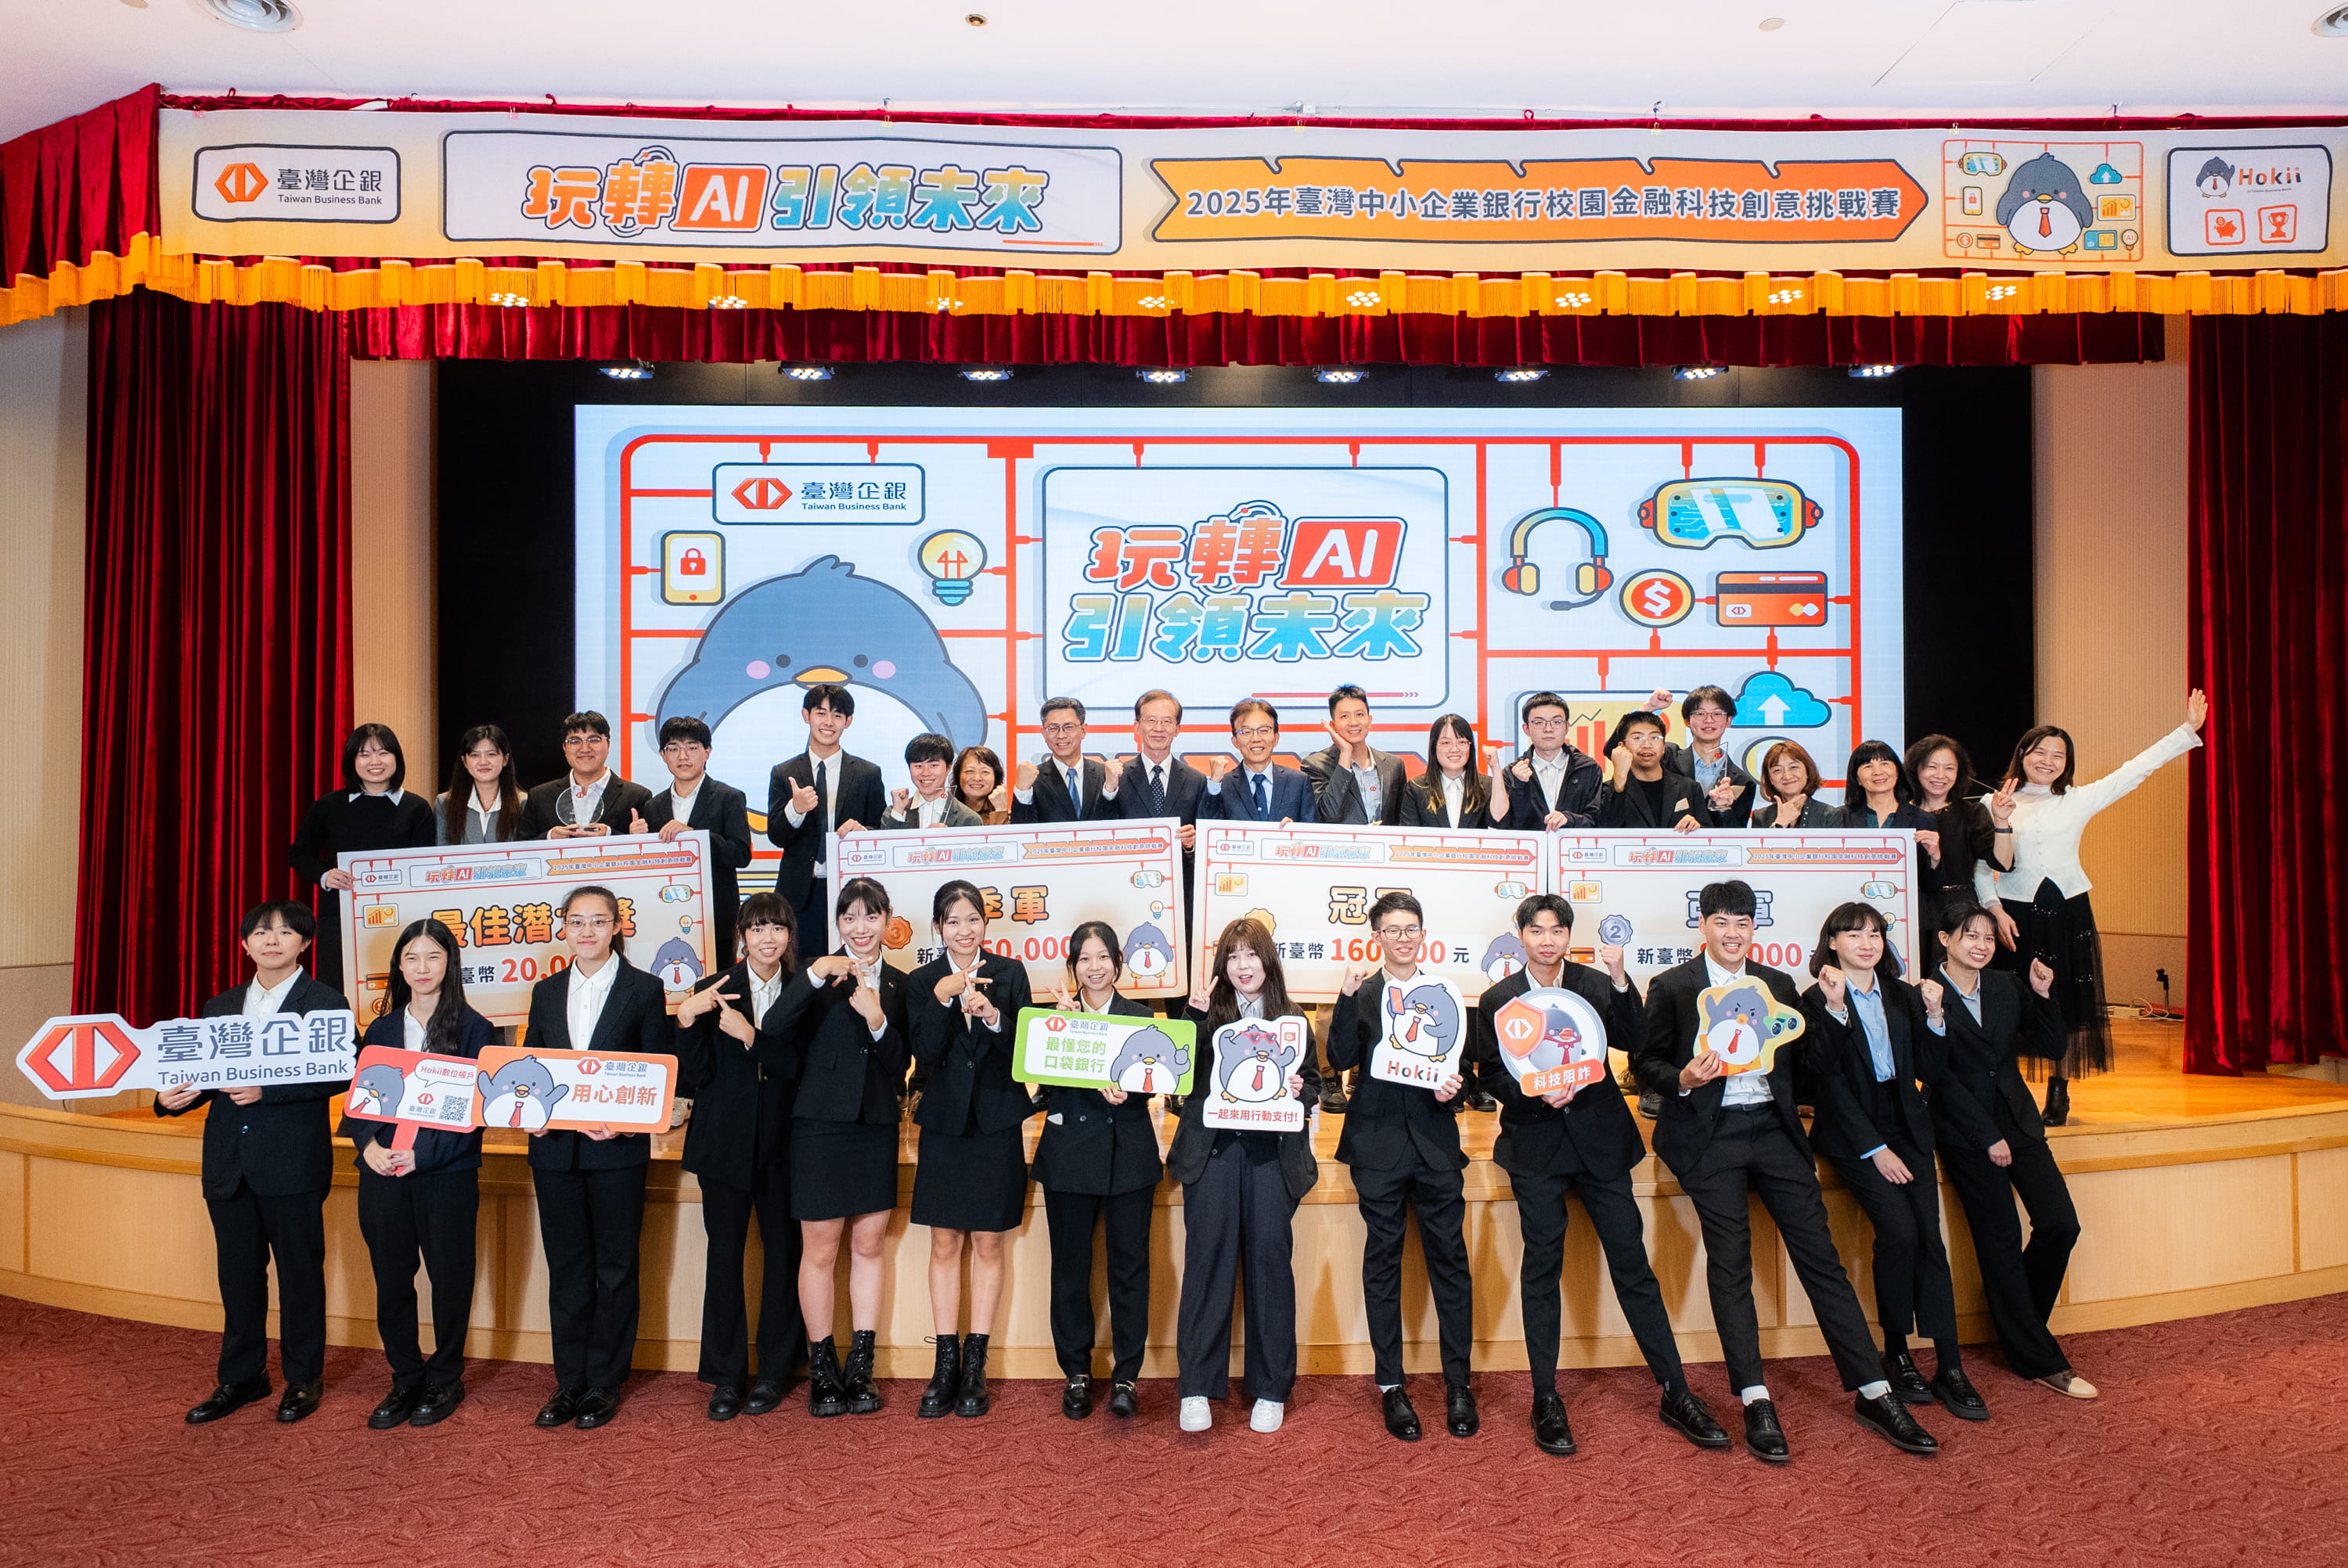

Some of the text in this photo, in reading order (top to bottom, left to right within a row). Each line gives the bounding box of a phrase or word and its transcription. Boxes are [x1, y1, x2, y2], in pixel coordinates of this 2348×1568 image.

[277, 168, 382, 192] 臺灣企銀
[2238, 166, 2302, 186] Hokii
[277, 193, 382, 205] Taiwan Business Bank
[523, 156, 1049, 234] 玩轉AI引領未來
[1187, 186, 1900, 219] 2025年臺灣中小企業銀行校園金融科技創意挑戰賽
[801, 481, 907, 500] 臺灣企銀
[801, 502, 907, 511] Taiwan Business Bank
[1085, 512, 1406, 592] 玩轉AI
[1063, 591, 1430, 662] 引領未來
[1610, 925, 1622, 938] 2
[1453, 948, 1470, 963] 元
[157, 1016, 348, 1063] 臺灣企銀
[1045, 1037, 1107, 1056] 最懂您的
[158, 1059, 348, 1085] Taiwan Business Bank
[604, 1061, 648, 1073] 臺灣企銀
[1044, 1055, 1105, 1073] 口袋銀行
[1386, 1059, 1439, 1084] Hokii
[1532, 1065, 1591, 1091] 科技阻詐
[571, 1084, 657, 1106] 用心創新
[1207, 1108, 1298, 1123] 一起來用行動支付!
